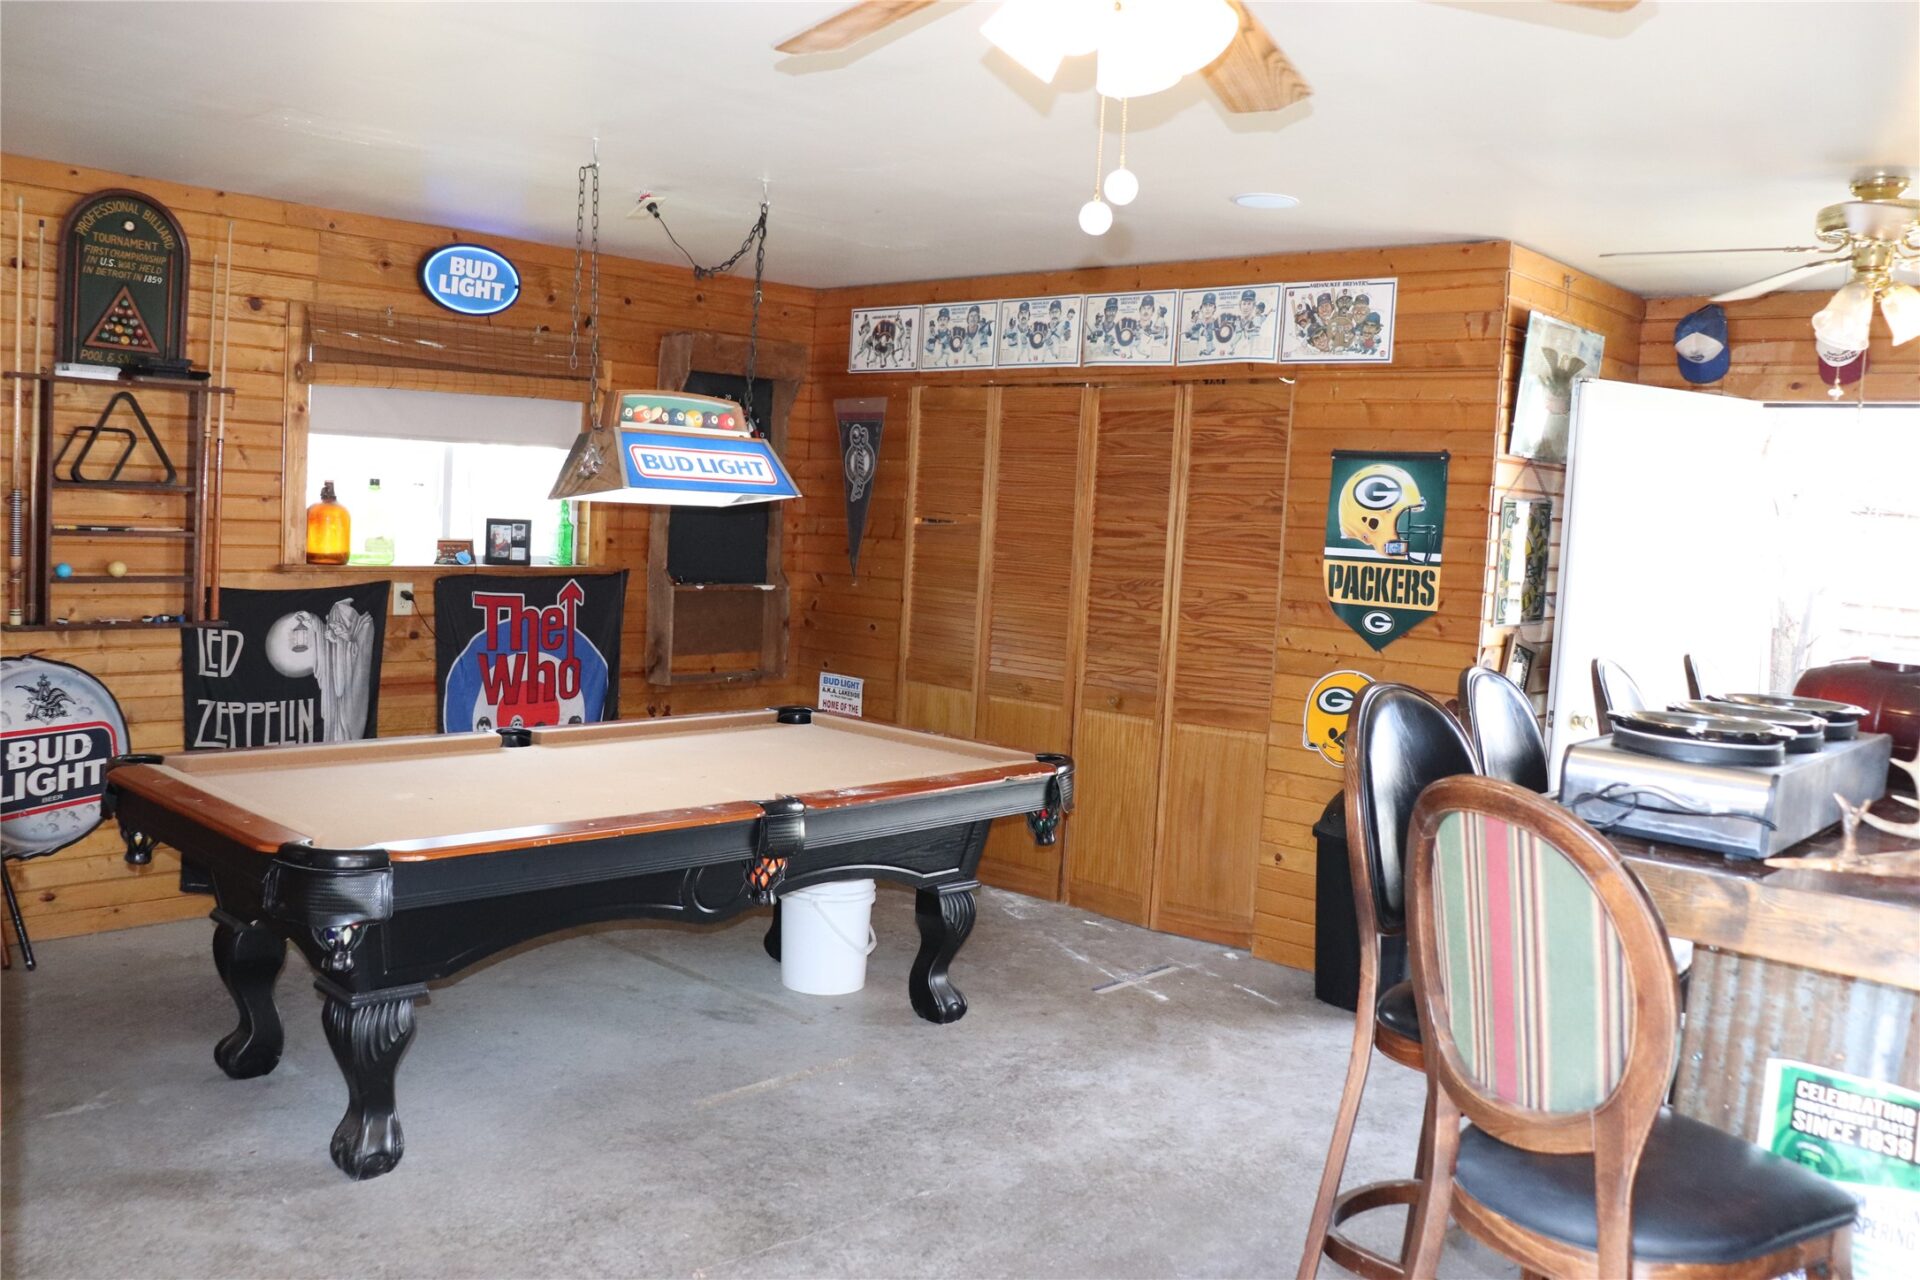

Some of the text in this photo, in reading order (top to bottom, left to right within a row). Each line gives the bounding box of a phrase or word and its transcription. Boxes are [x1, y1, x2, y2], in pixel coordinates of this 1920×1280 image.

[75, 200, 175, 249] PROFESSIONAL BILLIARD
[83, 244, 167, 264] FIRST CHAMPIONSHIP
[93, 231, 160, 250] TOURNAMENT
[82, 265, 163, 284] IN DETROIT IN 1859
[86, 255, 162, 275] IN U.S. WAS HELD
[449, 256, 498, 281] BUD
[439, 274, 505, 301] LIGHT
[80, 349, 104, 362] POOL
[641, 454, 763, 476] BUD LIGHT
[1328, 564, 1436, 607] PACKERS
[472, 591, 566, 651] The
[197, 628, 244, 678] LED
[477, 653, 582, 706] Who
[823, 676, 860, 690] BUD LIGHT
[823, 699, 839, 710] HOME
[840, 702, 847, 711] OF
[848, 704, 859, 714] THE
[194, 698, 314, 749] ZEPPELIN
[7, 733, 93, 771] BUD
[0, 758, 107, 804] LIGHT
[1796, 1080, 1917, 1128] CELEBRATING
[1791, 1109, 1857, 1145] SINCE
